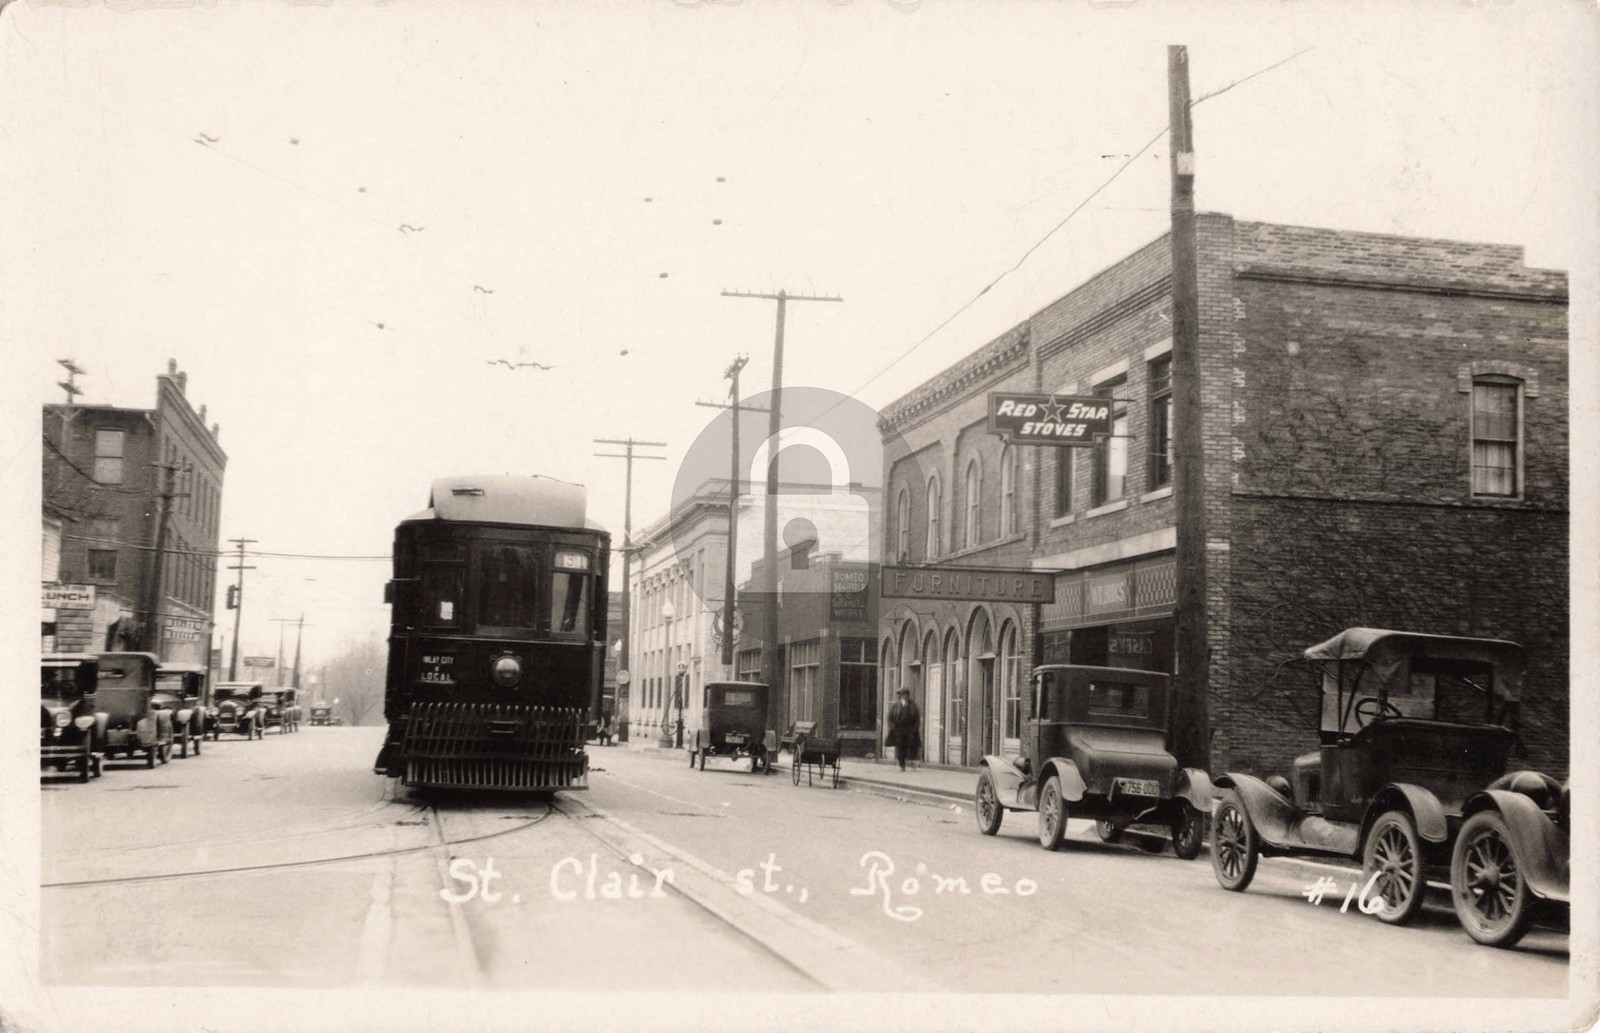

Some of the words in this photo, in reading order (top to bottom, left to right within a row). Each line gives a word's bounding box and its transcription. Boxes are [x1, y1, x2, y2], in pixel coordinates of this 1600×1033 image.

[997, 400, 1038, 418] RED
[1067, 403, 1109, 420] STAR
[1020, 421, 1087, 438] STOVES
[833, 571, 865, 582] ROMEO
[894, 572, 1043, 597] FURNITURE
[41, 592, 90, 601] UNCH
[421, 671, 452, 681] LOCAL
